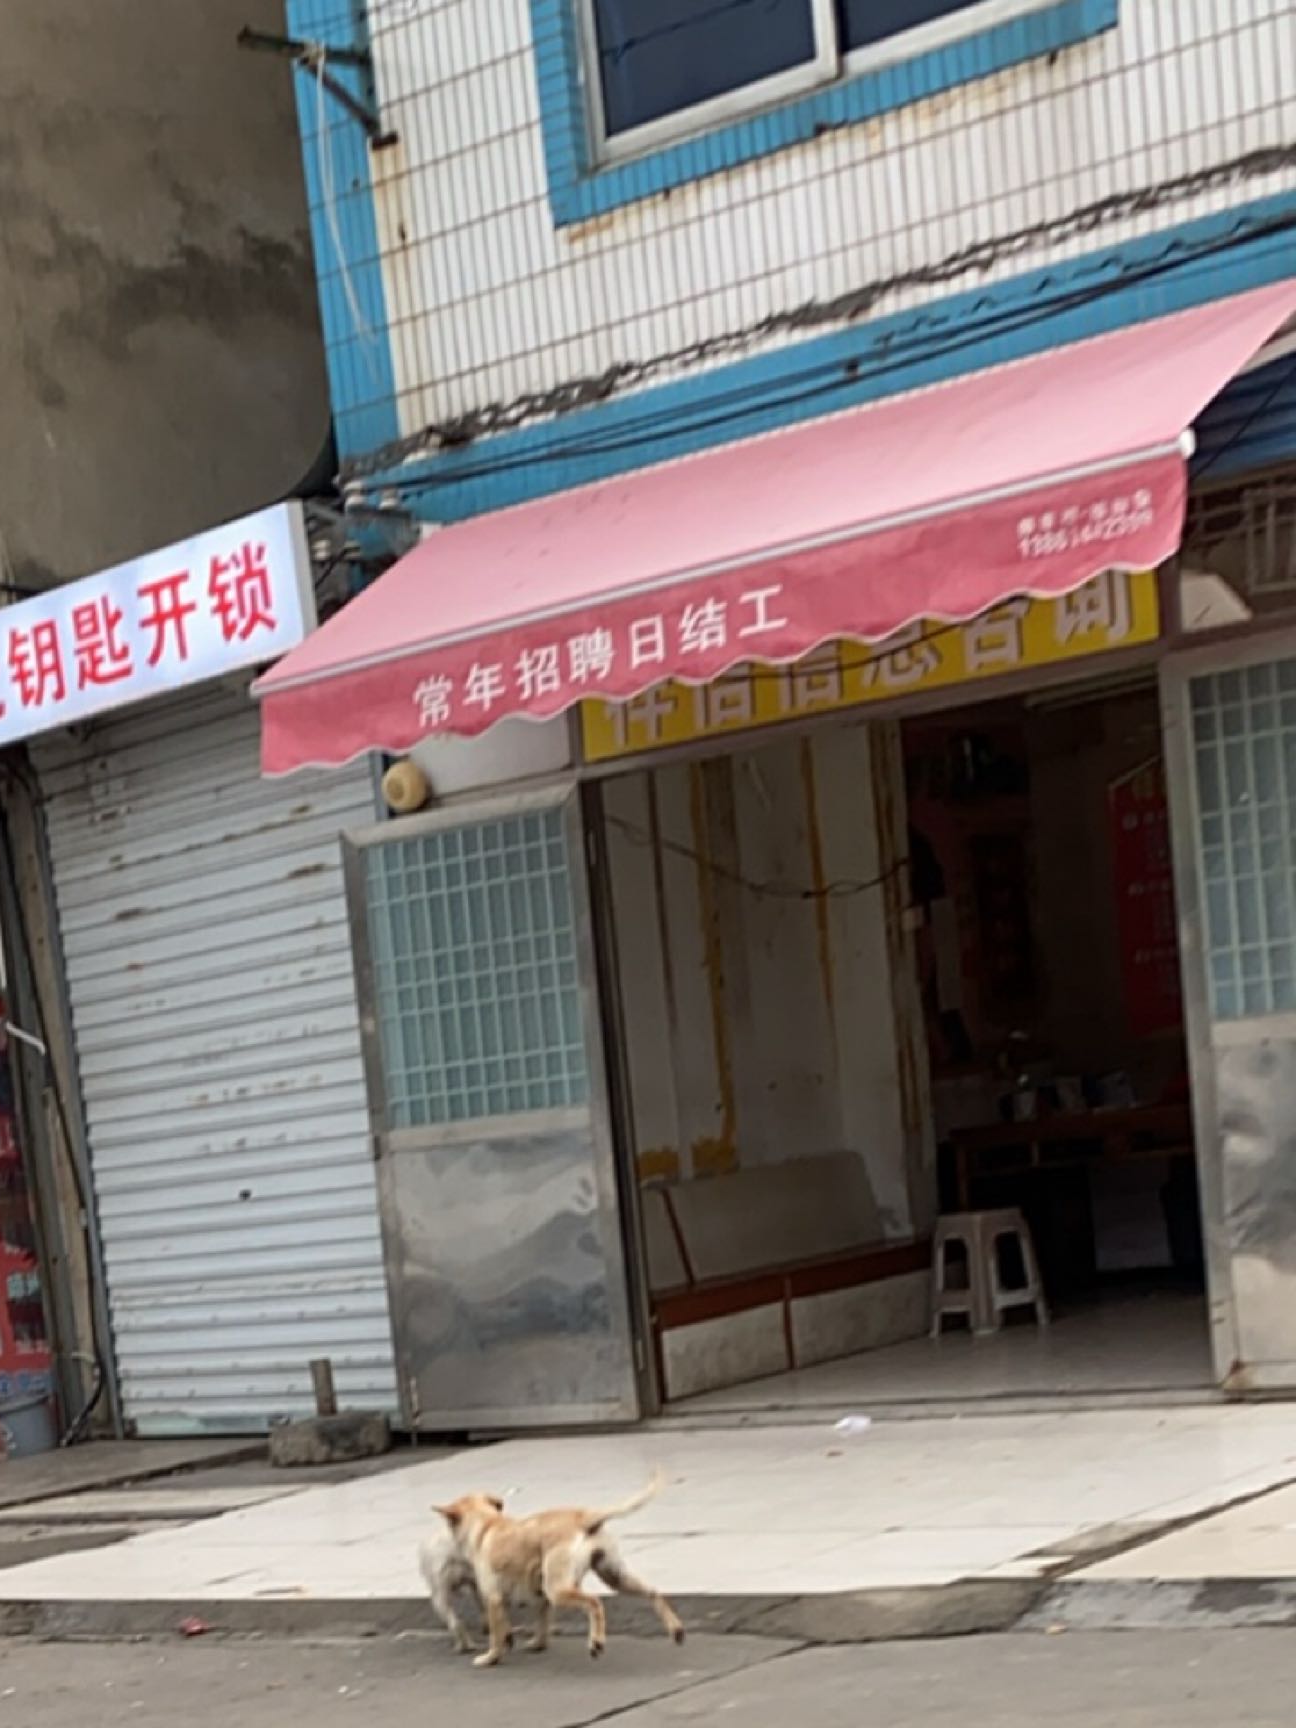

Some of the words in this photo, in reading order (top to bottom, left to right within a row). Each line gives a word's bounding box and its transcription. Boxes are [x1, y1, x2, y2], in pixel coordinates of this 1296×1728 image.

[413, 584, 787, 727] 常年招聘日结工
